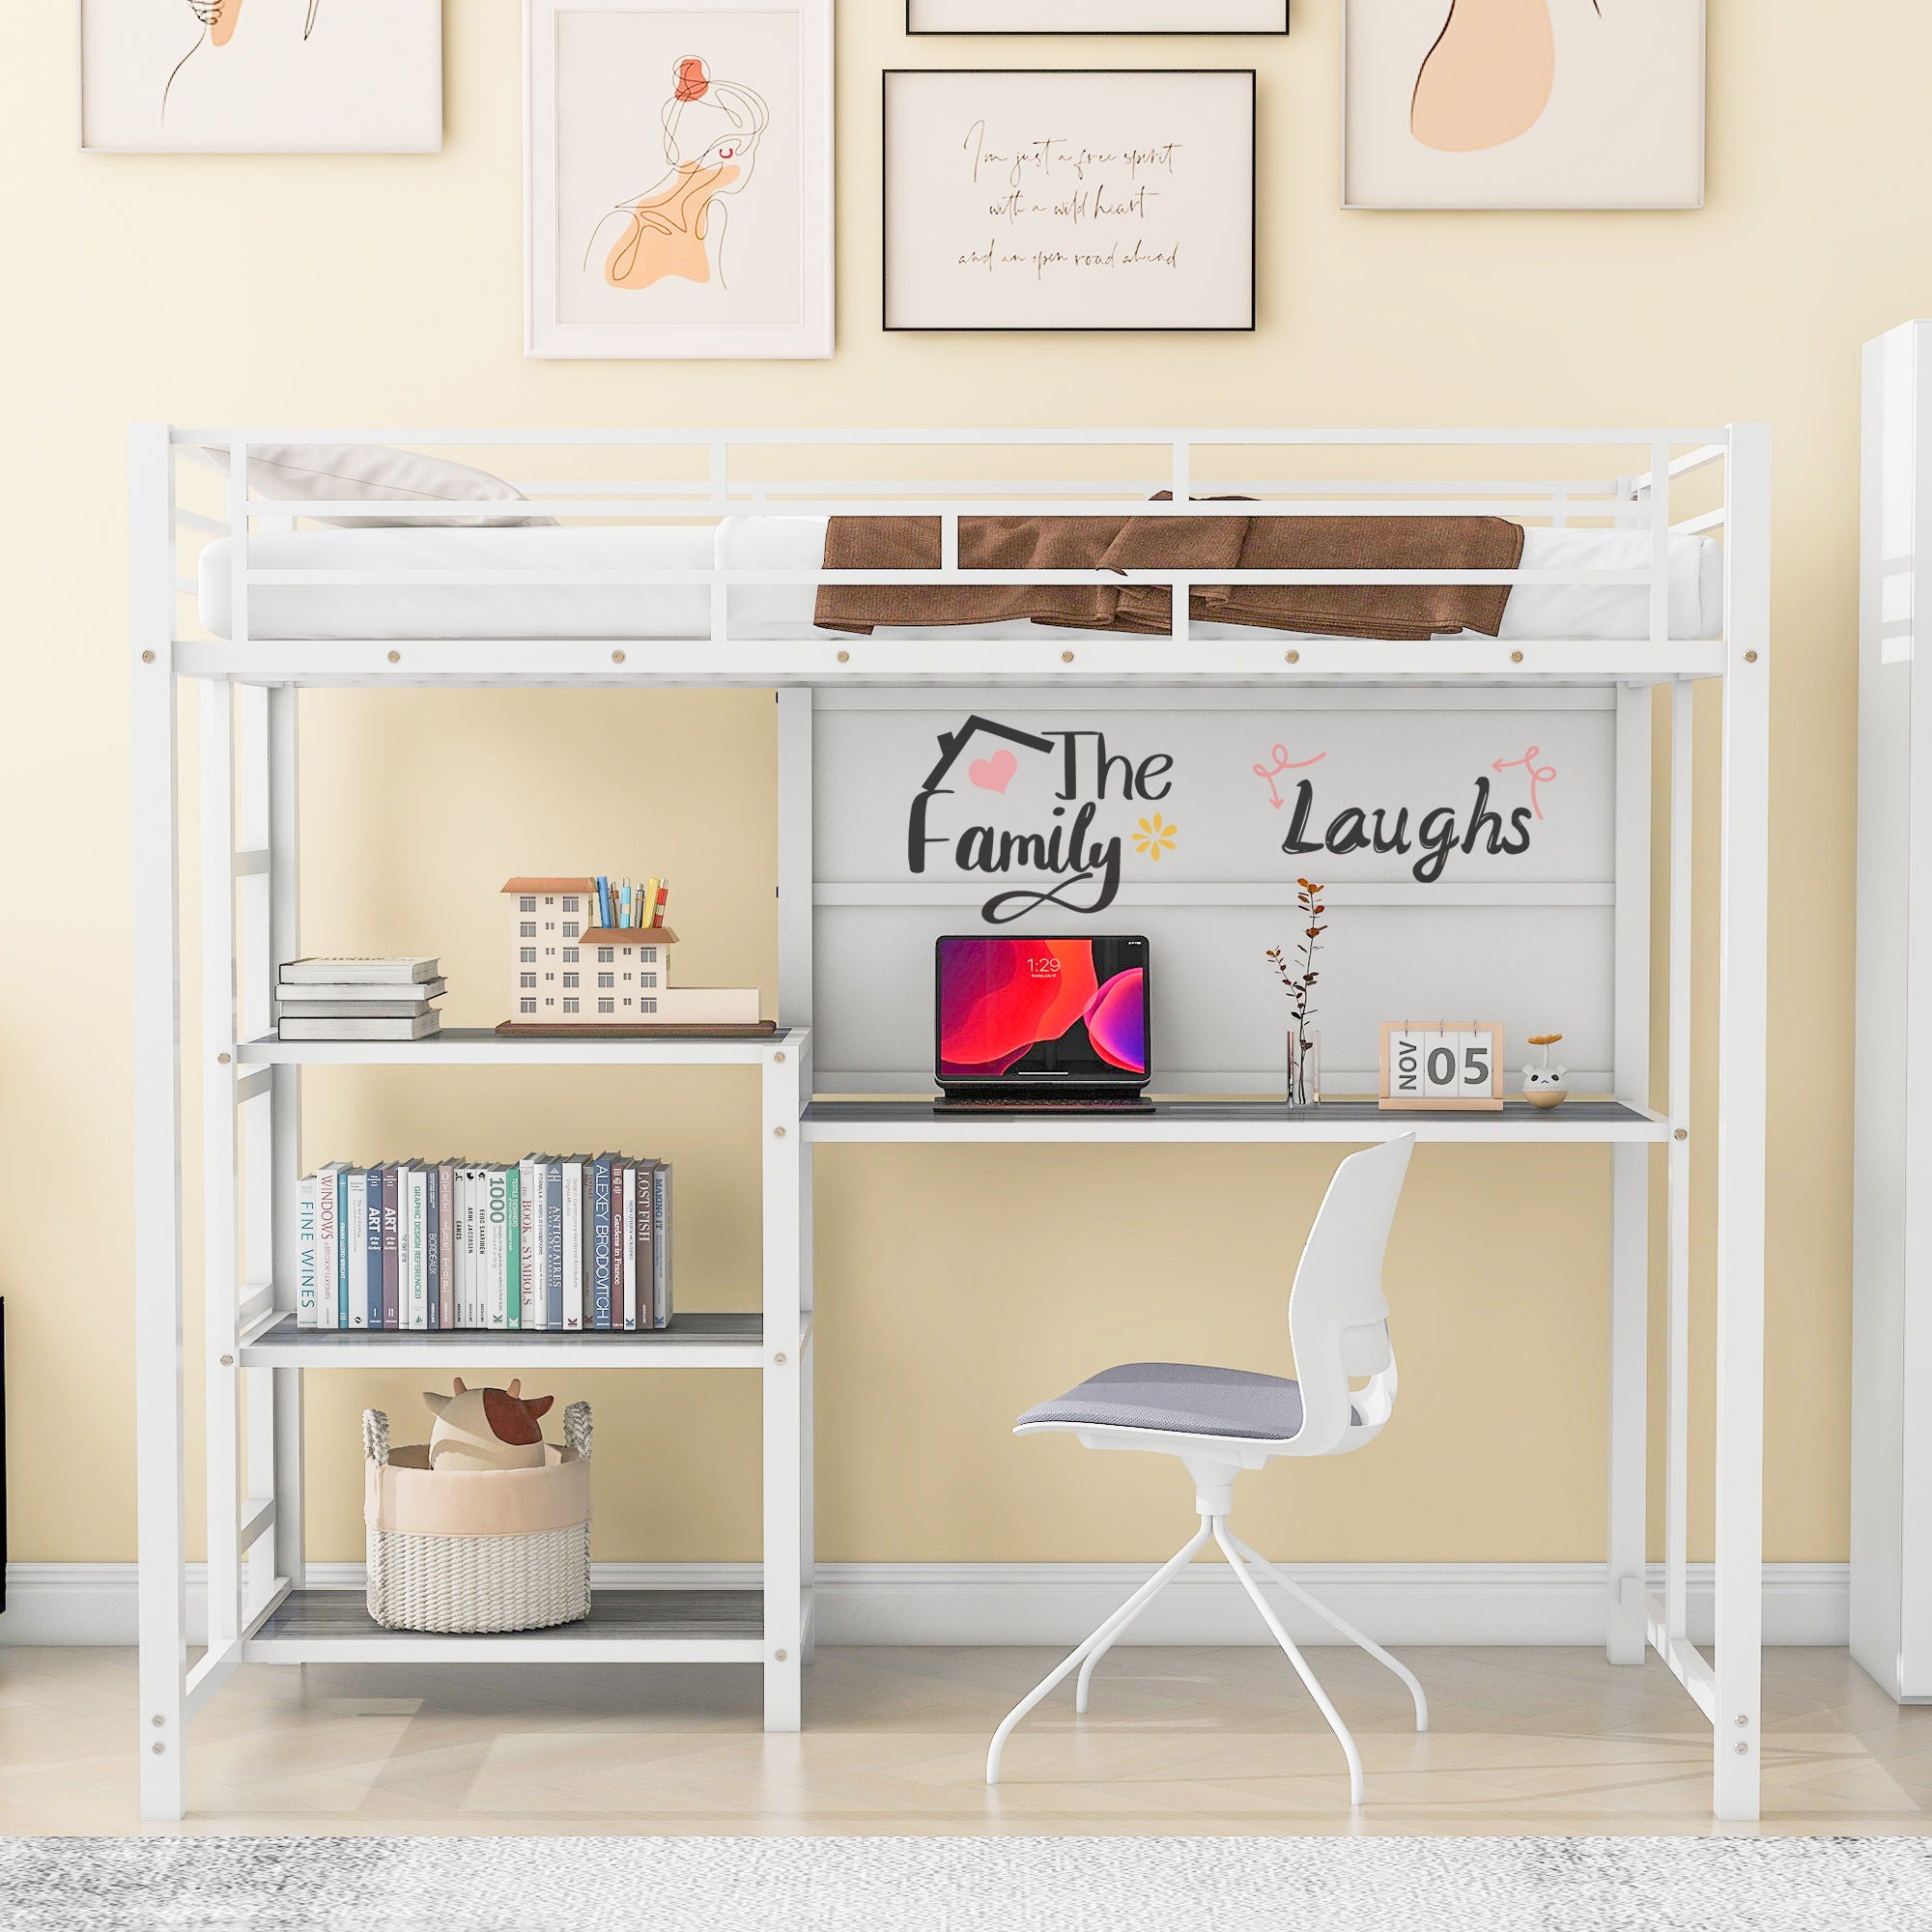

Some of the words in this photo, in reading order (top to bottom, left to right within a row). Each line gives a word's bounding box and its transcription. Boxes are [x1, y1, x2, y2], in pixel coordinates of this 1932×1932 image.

[1010, 138, 1067, 187] just
[1074, 149, 1117, 180] free
[1123, 143, 1183, 181] spirit
[989, 190, 1025, 224] with
[1032, 204, 1047, 213] a
[1053, 190, 1089, 224] wild
[1094, 185, 1160, 219] heart
[958, 238, 995, 271] and
[1002, 252, 1026, 263] an
[1032, 252, 1068, 281] open
[1074, 241, 1119, 268] road
[1122, 240, 1179, 269] ahead
[1040, 730, 1174, 801] The
[1281, 776, 1532, 883] Laughs
[908, 789, 1122, 924] Family
[1027, 957, 1061, 973] 1:29
[1398, 1040, 1417, 1091] NOV
[321, 1175, 333, 1240] WINDOWS
[490, 1178, 505, 1224] 1000
[596, 1164, 609, 1221] ALEXEY
[638, 1171, 649, 1208] LOST
[300, 1202, 314, 1240] FINE
[368, 1207, 381, 1234] ART
[384, 1207, 397, 1234] ART
[522, 1200, 532, 1234] BOOK
[639, 1210, 650, 1241] FISH
[655, 1219, 663, 1230] IT
[428, 1233, 438, 1275] BORDEAUX
[553, 1206, 561, 1288] ANTIQUAIRES
[614, 1248, 621, 1257] in
[301, 1249, 315, 1308] WINES
[522, 1246, 532, 1306] SYMBOLS
[596, 1225, 610, 1319] BRODOVITCH
